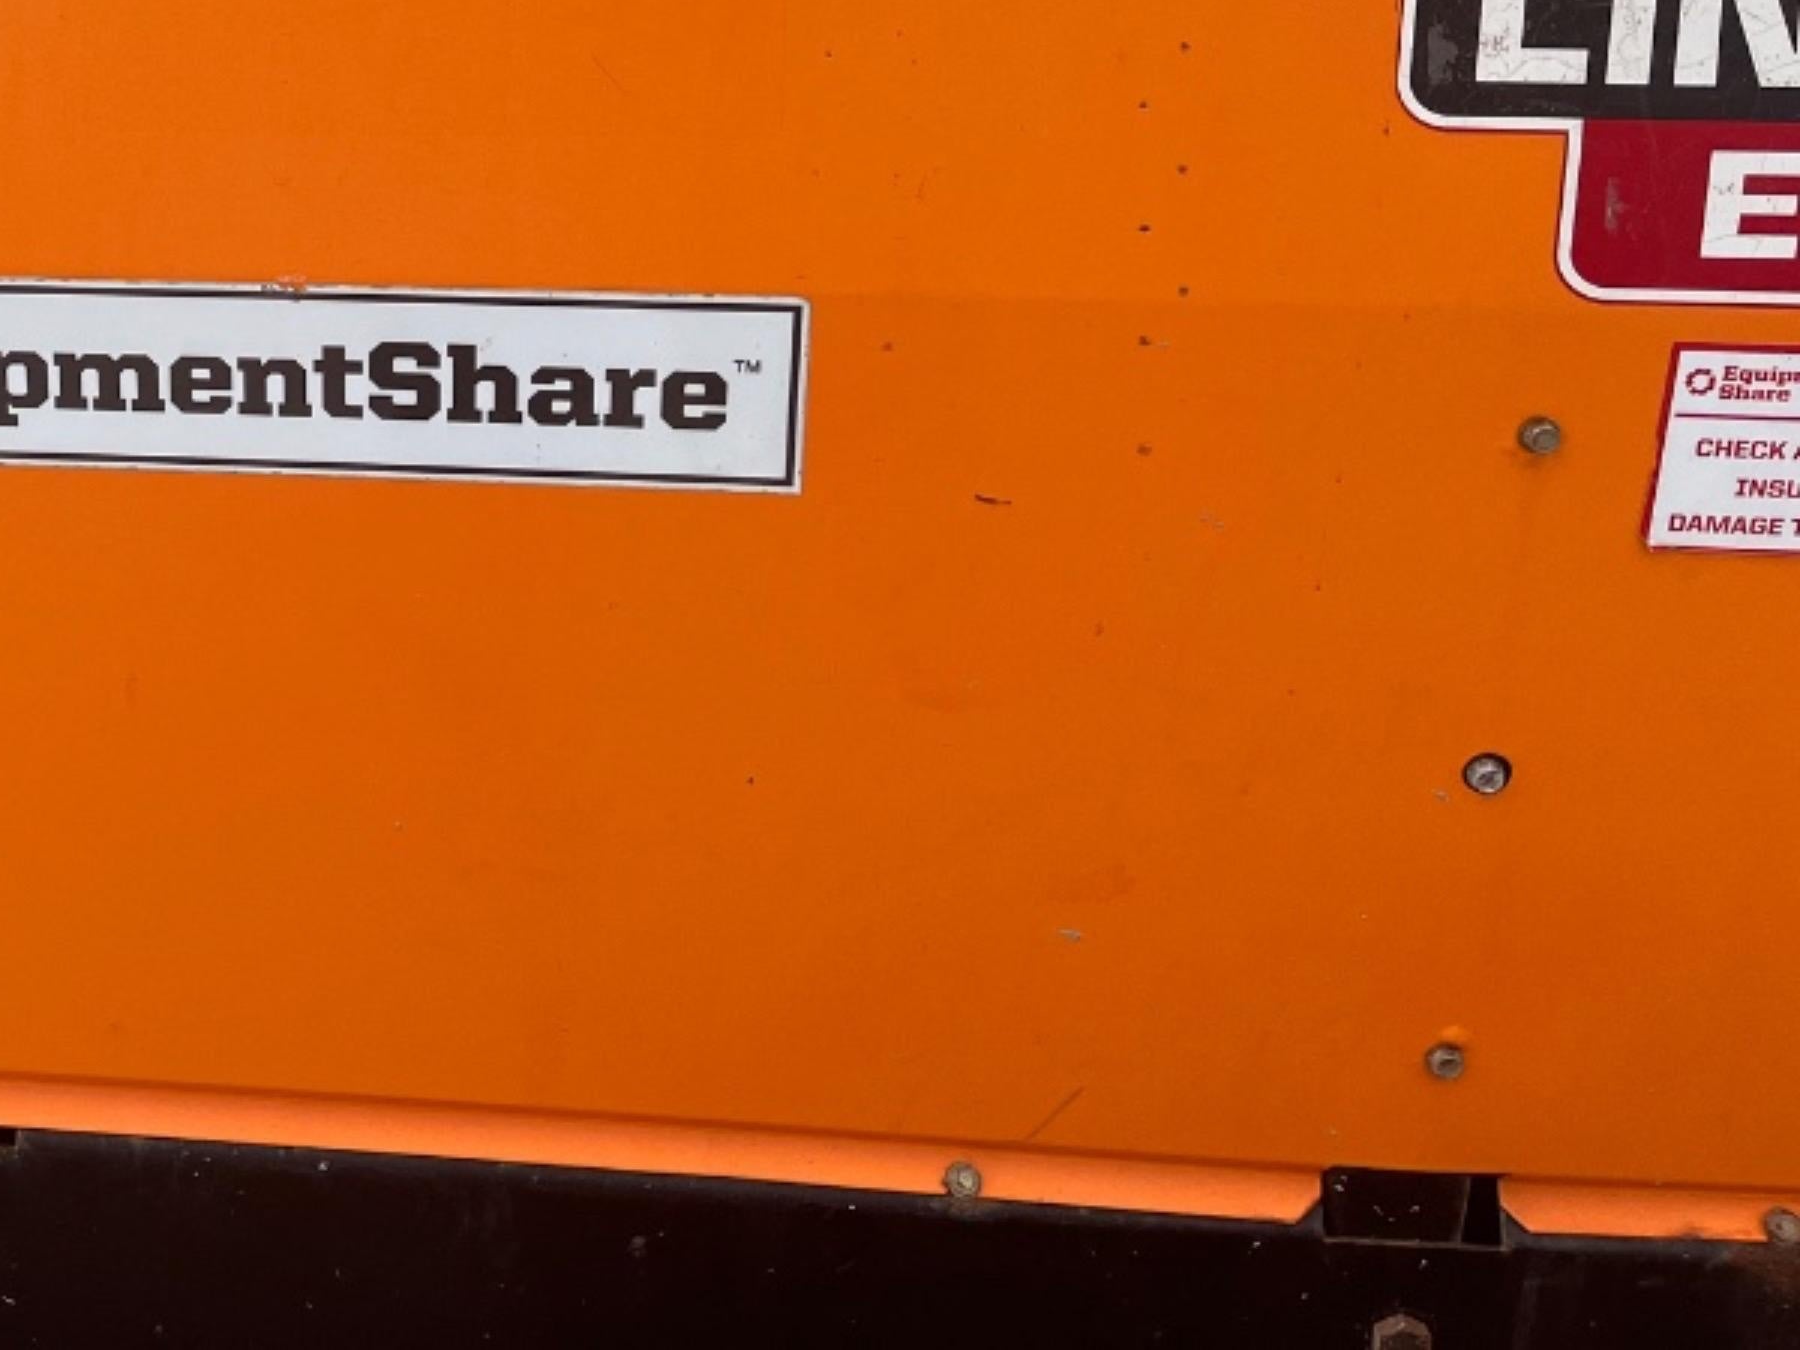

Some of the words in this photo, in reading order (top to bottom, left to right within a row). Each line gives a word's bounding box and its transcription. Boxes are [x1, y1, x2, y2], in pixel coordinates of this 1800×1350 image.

[1718, 384, 1791, 402] Share
[1695, 437, 1789, 459] CHECK
[1667, 513, 1785, 535] DAMAGE
